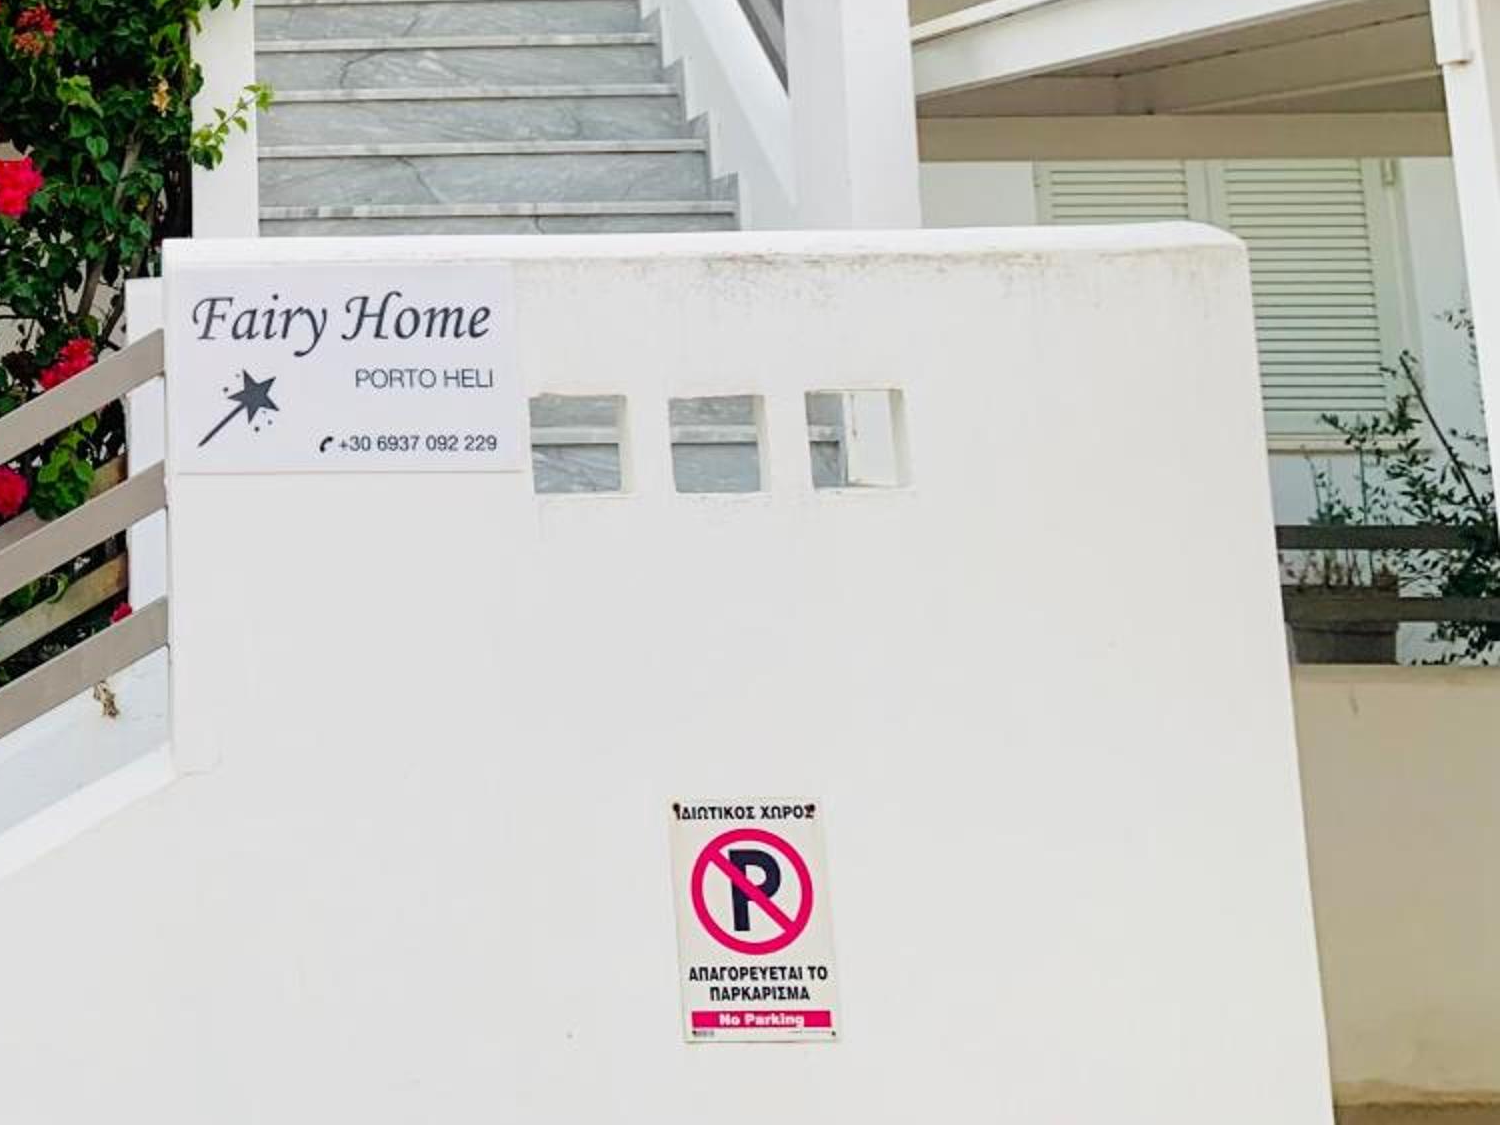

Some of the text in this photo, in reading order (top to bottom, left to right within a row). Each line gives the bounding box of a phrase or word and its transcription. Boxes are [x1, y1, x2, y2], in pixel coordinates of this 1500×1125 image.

[192, 291, 491, 358] Fairy Home
[355, 368, 495, 389] PORTO HELI
[337, 435, 498, 451] +30 6937 092 229
[689, 965, 828, 982] ΑΠΑΓΟΡΕΥΕΤΑΙ ΤΟ
[710, 986, 811, 1001] ΠΑΡΚΑΡΙΣΜΑ
[719, 1013, 805, 1028] No Parking
